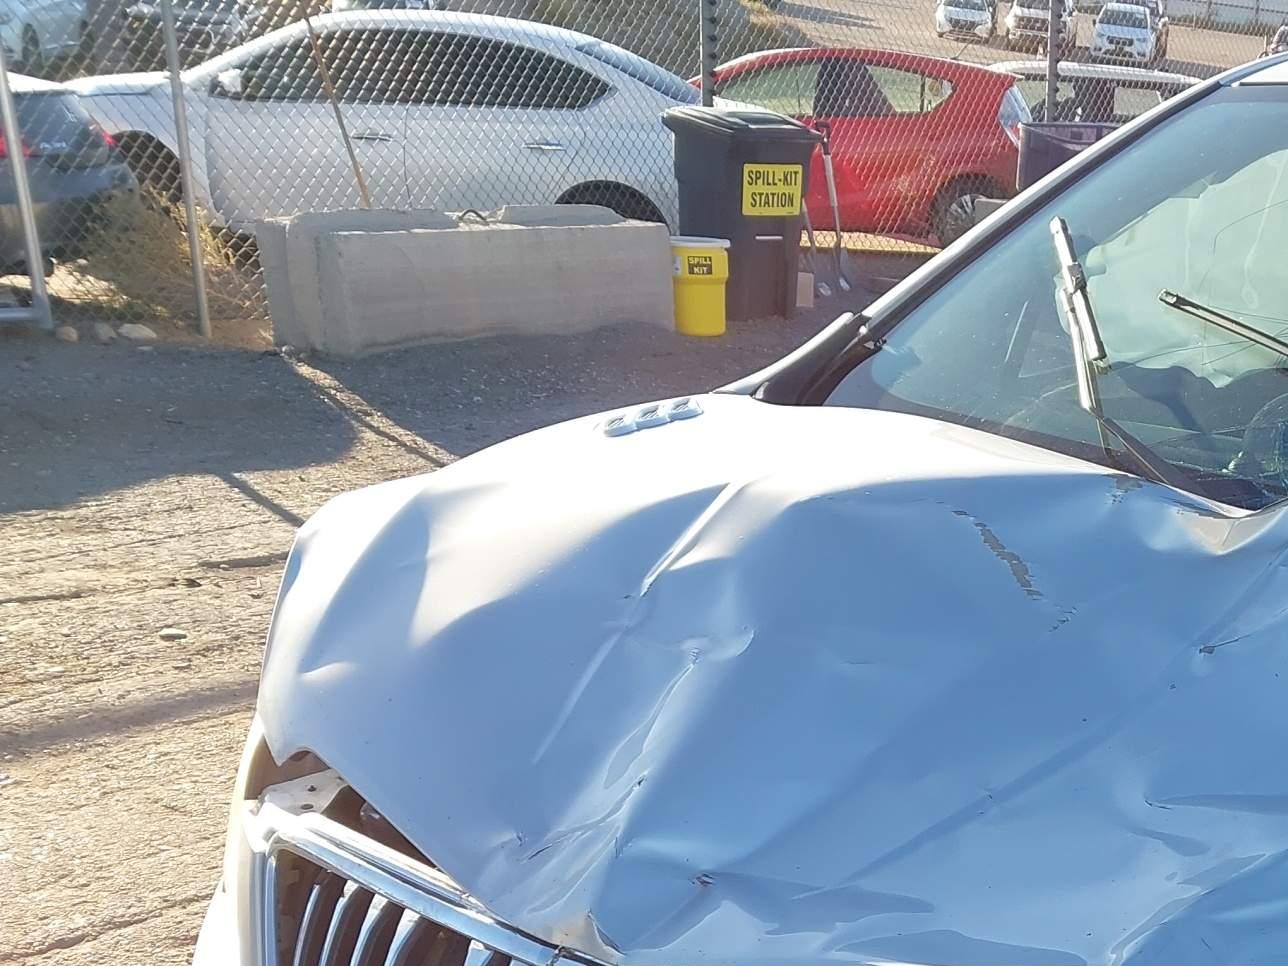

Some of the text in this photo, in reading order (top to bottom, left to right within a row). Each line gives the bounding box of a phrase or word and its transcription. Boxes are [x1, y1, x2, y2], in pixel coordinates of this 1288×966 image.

[747, 170, 800, 186] SPILL-KIT
[750, 192, 794, 208] STATION
[688, 257, 711, 265] SPILL
[693, 266, 708, 274] KIT
